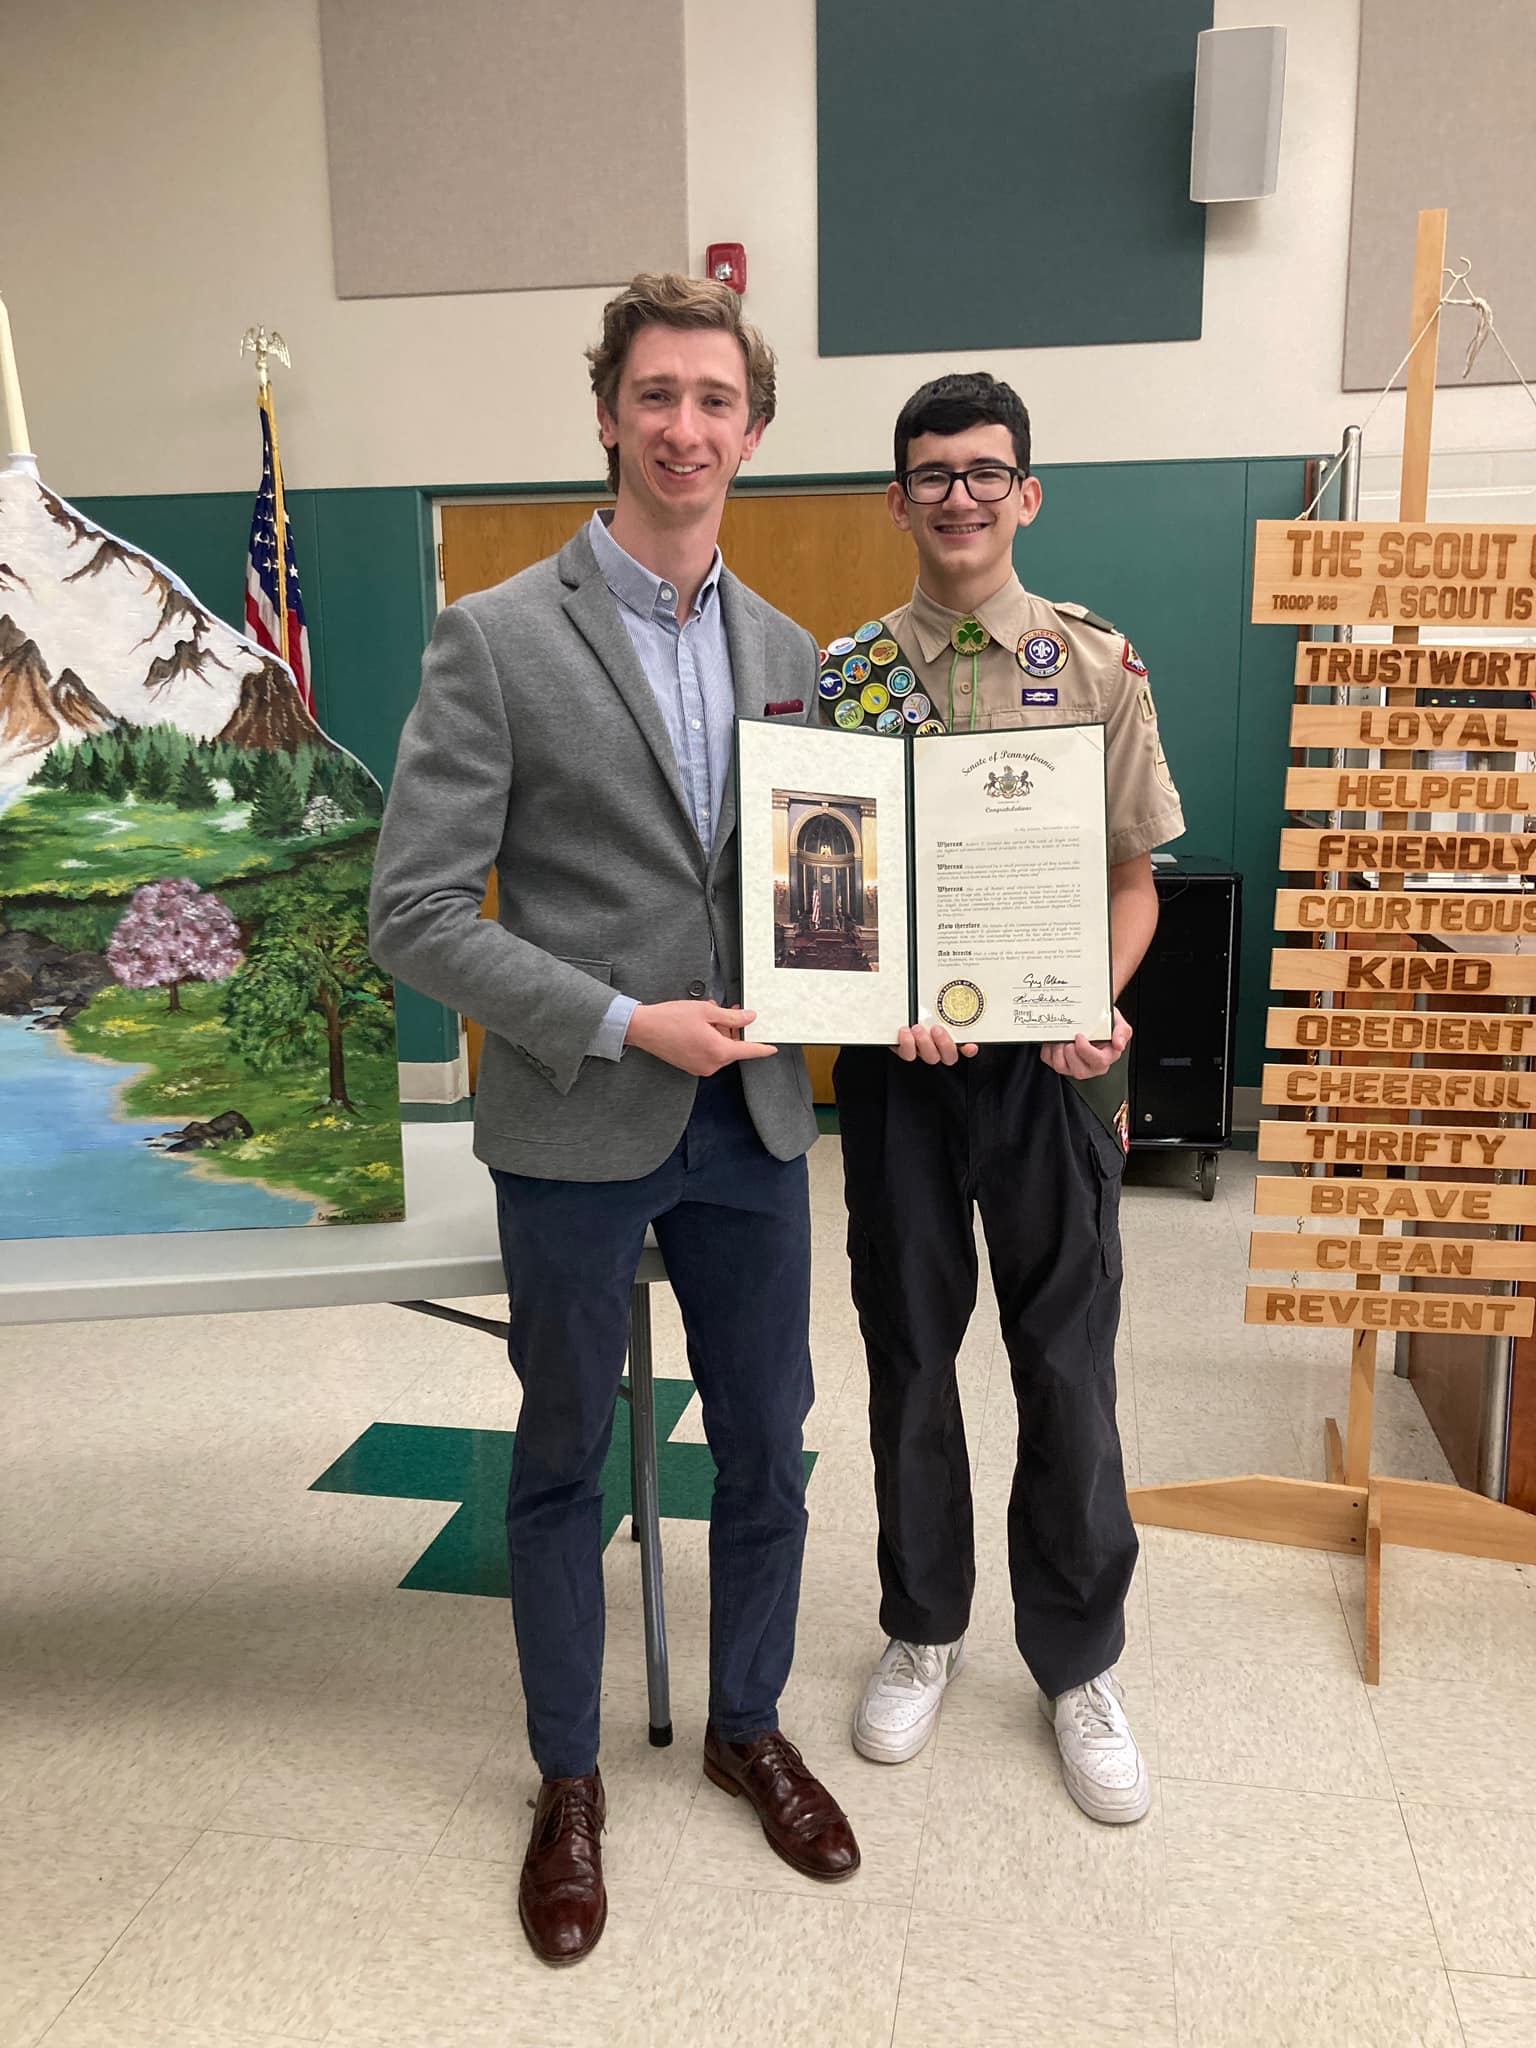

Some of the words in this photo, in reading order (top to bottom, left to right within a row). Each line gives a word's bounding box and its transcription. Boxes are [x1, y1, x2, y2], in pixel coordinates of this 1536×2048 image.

[1287, 530, 1364, 577] THE
[1377, 531, 1517, 580] SCOUT
[1272, 594, 1313, 611] TROOP
[1317, 595, 1338, 611] 168
[1369, 585, 1389, 618] A
[1400, 585, 1497, 620] SCOUT
[1505, 586, 1534, 620] IS
[1305, 647, 1536, 687] TRUSTWORT
[1360, 711, 1518, 747] LOYAL
[962, 757, 986, 776] Senate
[989, 751, 998, 763] of
[1000, 750, 1055, 772] Pennsylvania
[1337, 775, 1529, 811] HELPFUL
[1318, 834, 1536, 872] FRIENDLY
[1346, 956, 1492, 992] KIND
[1296, 1014, 1533, 1052] OBEDIENT
[1286, 1070, 1532, 1109] CHEERFUL
[1306, 1129, 1506, 1165] THRIFTY
[1310, 1185, 1492, 1219] BRAVE
[1316, 1239, 1474, 1275] CLEAN
[1266, 1292, 1515, 1331] REVERENT
